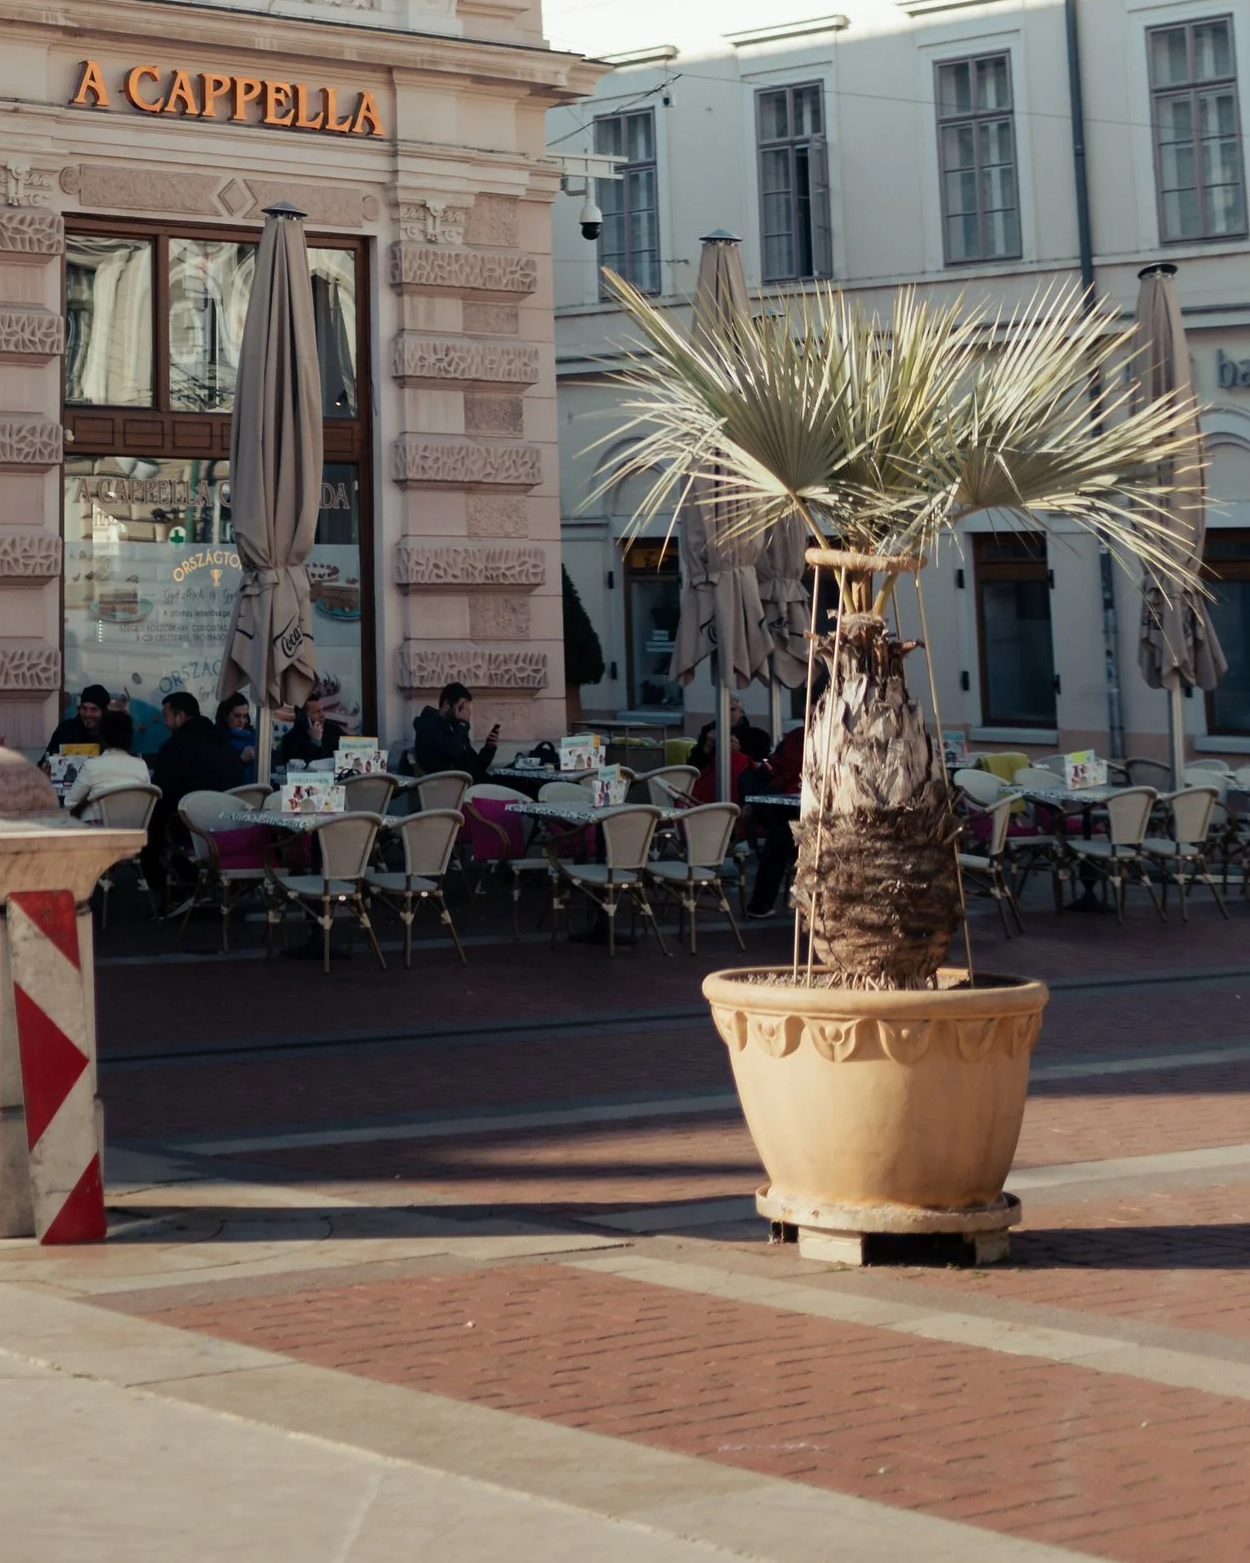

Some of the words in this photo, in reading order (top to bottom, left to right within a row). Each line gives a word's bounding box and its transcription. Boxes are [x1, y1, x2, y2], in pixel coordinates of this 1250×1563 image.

[69, 60, 110, 107] A
[123, 65, 385, 135] CAPPELLA
[74, 477, 91, 504] A
[99, 477, 213, 508] CAPPELLA
